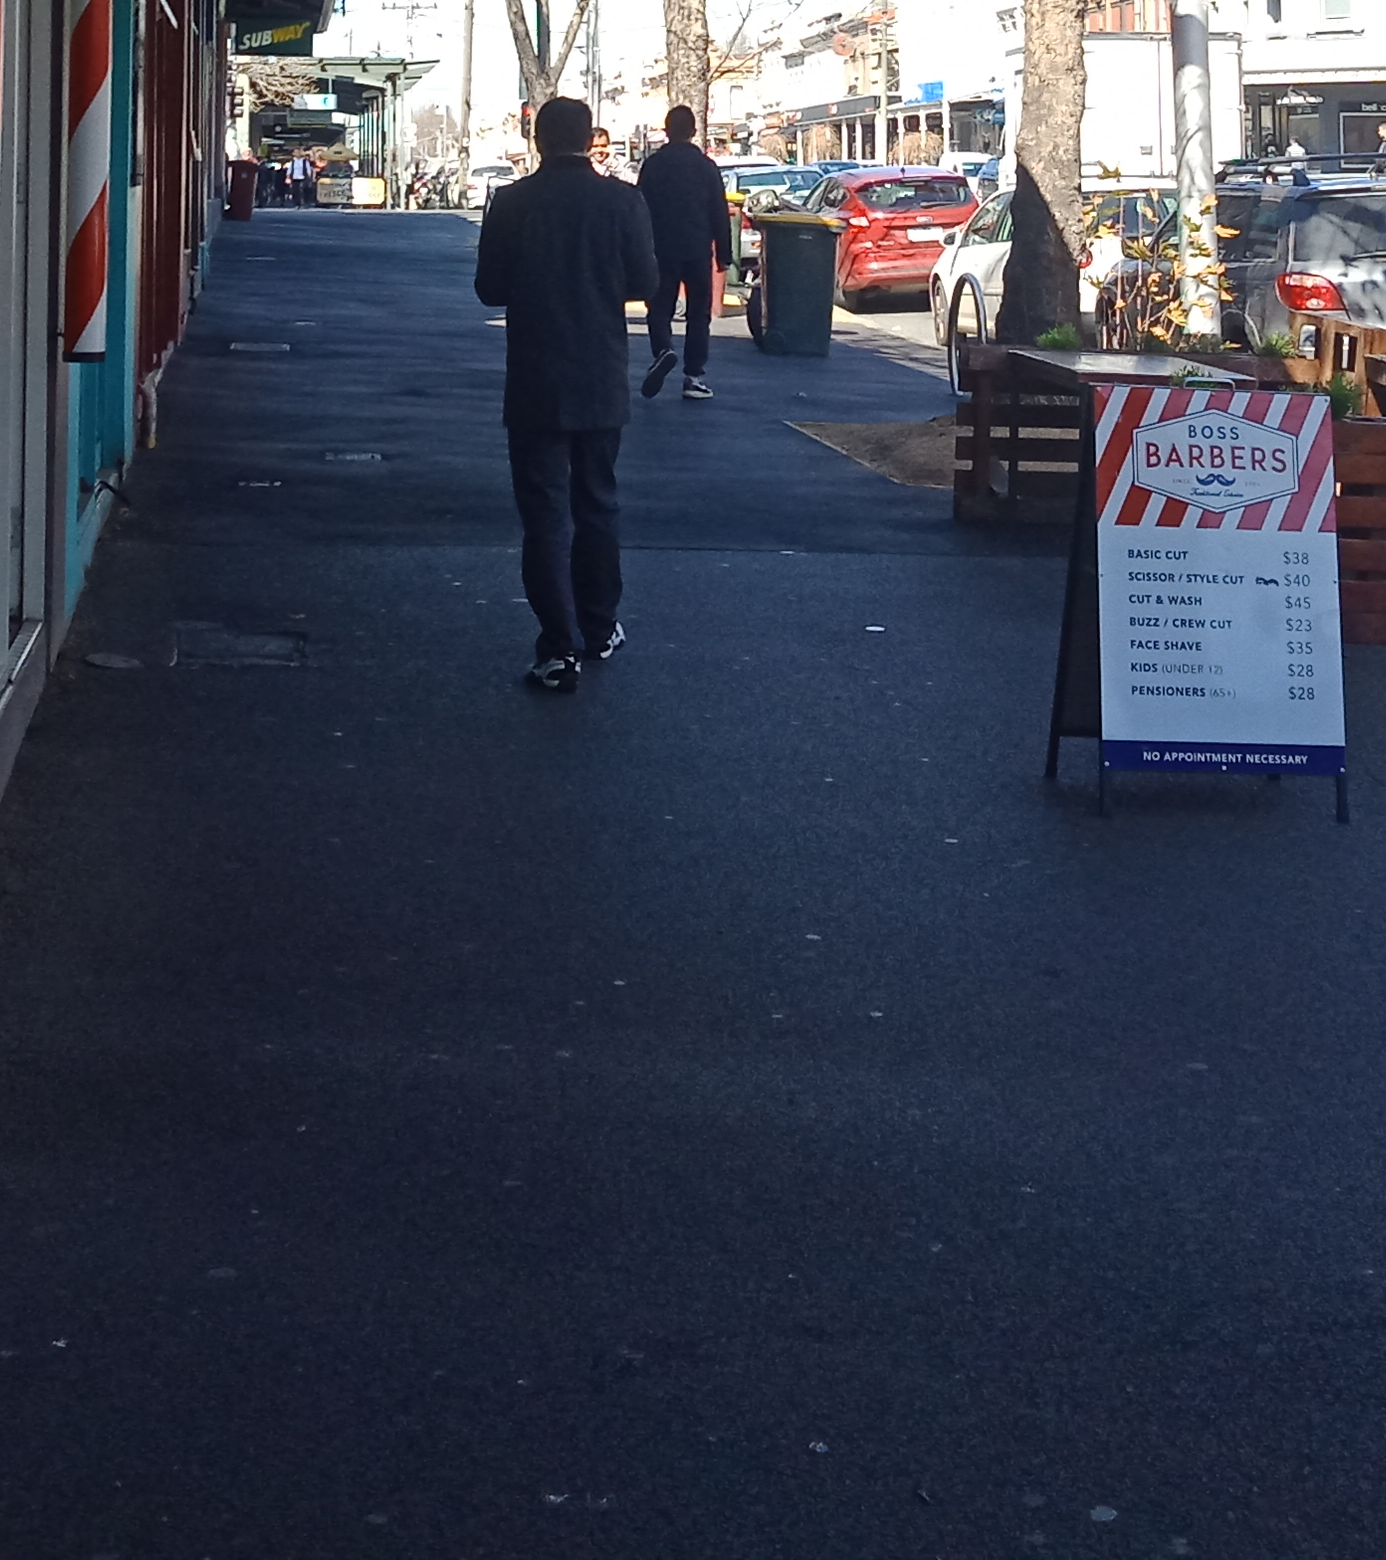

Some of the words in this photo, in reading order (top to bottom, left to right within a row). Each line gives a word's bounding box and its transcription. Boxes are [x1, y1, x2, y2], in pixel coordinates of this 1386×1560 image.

[238, 21, 312, 50] SUBWAY
[1187, 424, 1241, 441] BOSS
[1144, 441, 1288, 473] BARBERS
[1127, 549, 1162, 560] BASIC
[1165, 550, 1189, 561] CUT
[1282, 551, 1310, 566] $38
[1128, 571, 1175, 583] SCISSOR
[1186, 574, 1219, 585] STYLE
[1222, 575, 1245, 585] CUT
[1284, 573, 1311, 588] $40
[1128, 594, 1152, 605] CUT
[1155, 595, 1164, 605] &
[1167, 596, 1203, 606] WASH
[1284, 596, 1311, 610] $45
[1129, 617, 1161, 628] BUZZ
[1172, 618, 1206, 629] CREW
[1209, 620, 1233, 630] CUT
[1285, 618, 1312, 633] $23
[1130, 640, 1161, 651] FACE
[1164, 641, 1203, 652] SHAVE
[1286, 641, 1314, 655] $35
[1130, 662, 1158, 673] KIDS
[1161, 663, 1204, 675] (UNDER
[1208, 664, 1223, 676] 12)
[1287, 663, 1314, 678] $28
[1131, 685, 1207, 697] PENSIONERS
[1209, 687, 1237, 700] (65+)
[1288, 686, 1315, 701] $28
[1143, 751, 1160, 762] NO
[1163, 751, 1243, 763] APPOINTMENT
[1245, 753, 1309, 765] NECESSARY
